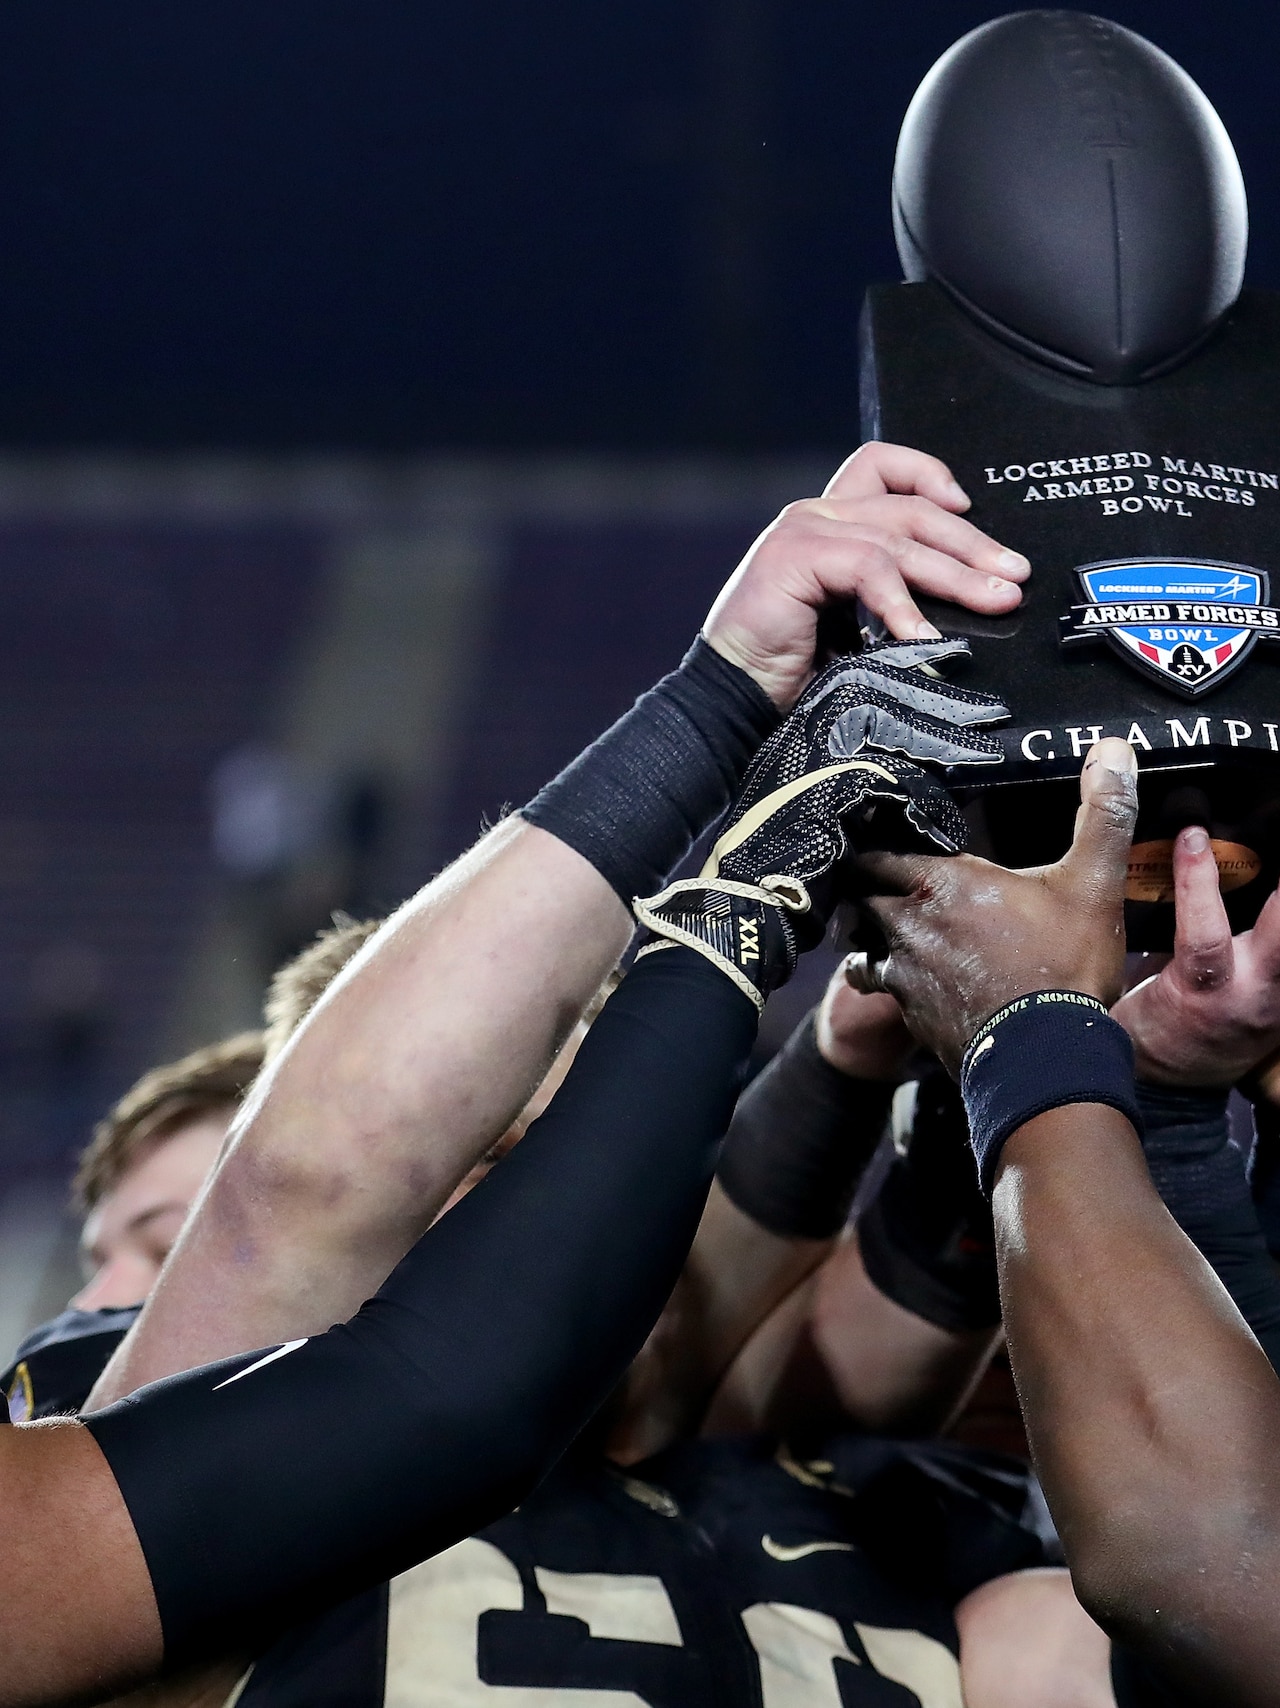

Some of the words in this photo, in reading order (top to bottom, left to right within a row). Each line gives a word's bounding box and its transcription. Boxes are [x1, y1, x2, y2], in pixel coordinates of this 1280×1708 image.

[984, 452, 1151, 483] LOCKHEED
[1161, 456, 1279, 489] MARTIN
[1023, 475, 1135, 502] ARMED
[1145, 474, 1256, 507] FORCES
[1100, 495, 1192, 517] BOWL
[1099, 585, 1163, 594] LOCKHEED
[1165, 585, 1215, 594] MARTIN
[1082, 605, 1172, 625] ARMED
[1178, 604, 1279, 627] FORCES
[1149, 628, 1219, 642] BOWL
[1178, 664, 1204, 676] XV
[739, 916, 760, 965] XXL
[1036, 993, 1109, 1016] RANDON
